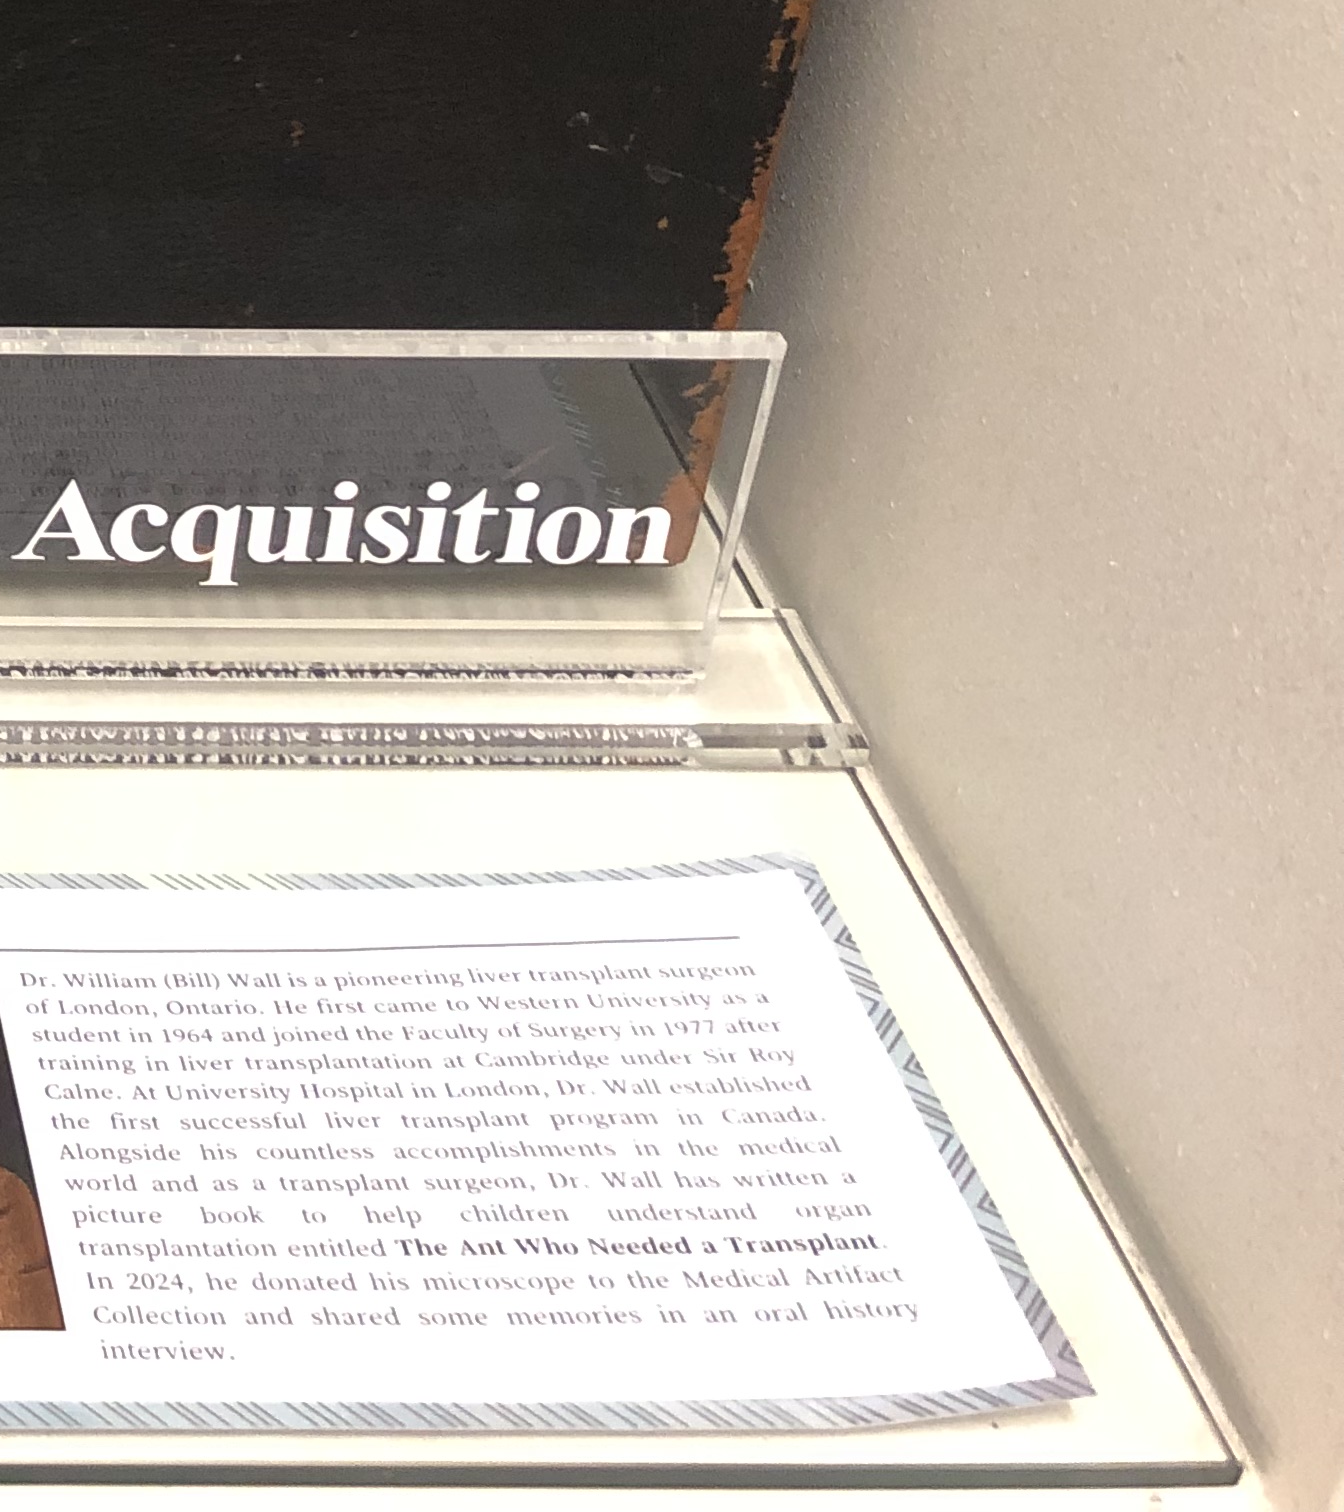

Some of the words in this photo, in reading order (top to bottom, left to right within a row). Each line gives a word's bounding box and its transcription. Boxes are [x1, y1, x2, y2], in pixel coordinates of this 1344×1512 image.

[11, 478, 671, 586] Acquisition
[19, 971, 56, 988] Dr.
[62, 972, 157, 989] William
[163, 971, 221, 991] (Bill)
[226, 972, 282, 989] Wall
[286, 971, 308, 989] is
[314, 975, 328, 988] a
[333, 968, 464, 992] pioneering
[465, 967, 521, 985] liver
[528, 964, 652, 986] transplant
[658, 965, 757, 981] surgeon
[25, 997, 49, 1015] of
[57, 998, 158, 1019] London,
[165, 999, 265, 1016] Ontario.
[273, 999, 308, 1016] He
[316, 997, 366, 1015] first
[373, 1000, 437, 1015] came
[445, 998, 470, 1012] to
[476, 995, 580, 1011] Western
[586, 991, 711, 1011] University
[722, 993, 747, 1006] as
[756, 992, 770, 1005] a
[32, 1026, 121, 1043] student
[128, 1026, 153, 1044] in
[162, 1027, 213, 1044] 1964
[221, 1025, 266, 1043] and
[272, 1024, 349, 1048] joined
[355, 1024, 394, 1042] the
[401, 1023, 488, 1044] Faculty
[497, 1021, 522, 1039] of
[527, 1022, 621, 1041] Surgery
[630, 1020, 656, 1037] in
[663, 1018, 714, 1037] 1977
[726, 1018, 780, 1035] after
[50, 1111, 90, 1131] the
[110, 1111, 160, 1131] first
[179, 1111, 307, 1131] successful
[324, 1111, 381, 1130] liver
[400, 1110, 530, 1133] transplant
[549, 1112, 659, 1132] program
[678, 1108, 704, 1127] in
[721, 1105, 826, 1125] Canada.
[59, 1142, 181, 1165] Alongside
[199, 1142, 238, 1162] his
[256, 1142, 375, 1161] countless
[393, 1140, 617, 1164] accomplishments
[634, 1139, 661, 1157] in
[677, 1139, 718, 1157] the
[738, 1134, 842, 1157] medical
[78, 1238, 277, 1263] transplantation
[287, 1237, 387, 1258] entitled
[393, 1237, 448, 1258] The
[460, 1239, 507, 1257] Ant
[513, 1236, 579, 1256] Who
[587, 1235, 693, 1256] Needed
[701, 1240, 719, 1256] a
[722, 1232, 888, 1257] Transplant.
[100, 1338, 235, 1361] interview.
